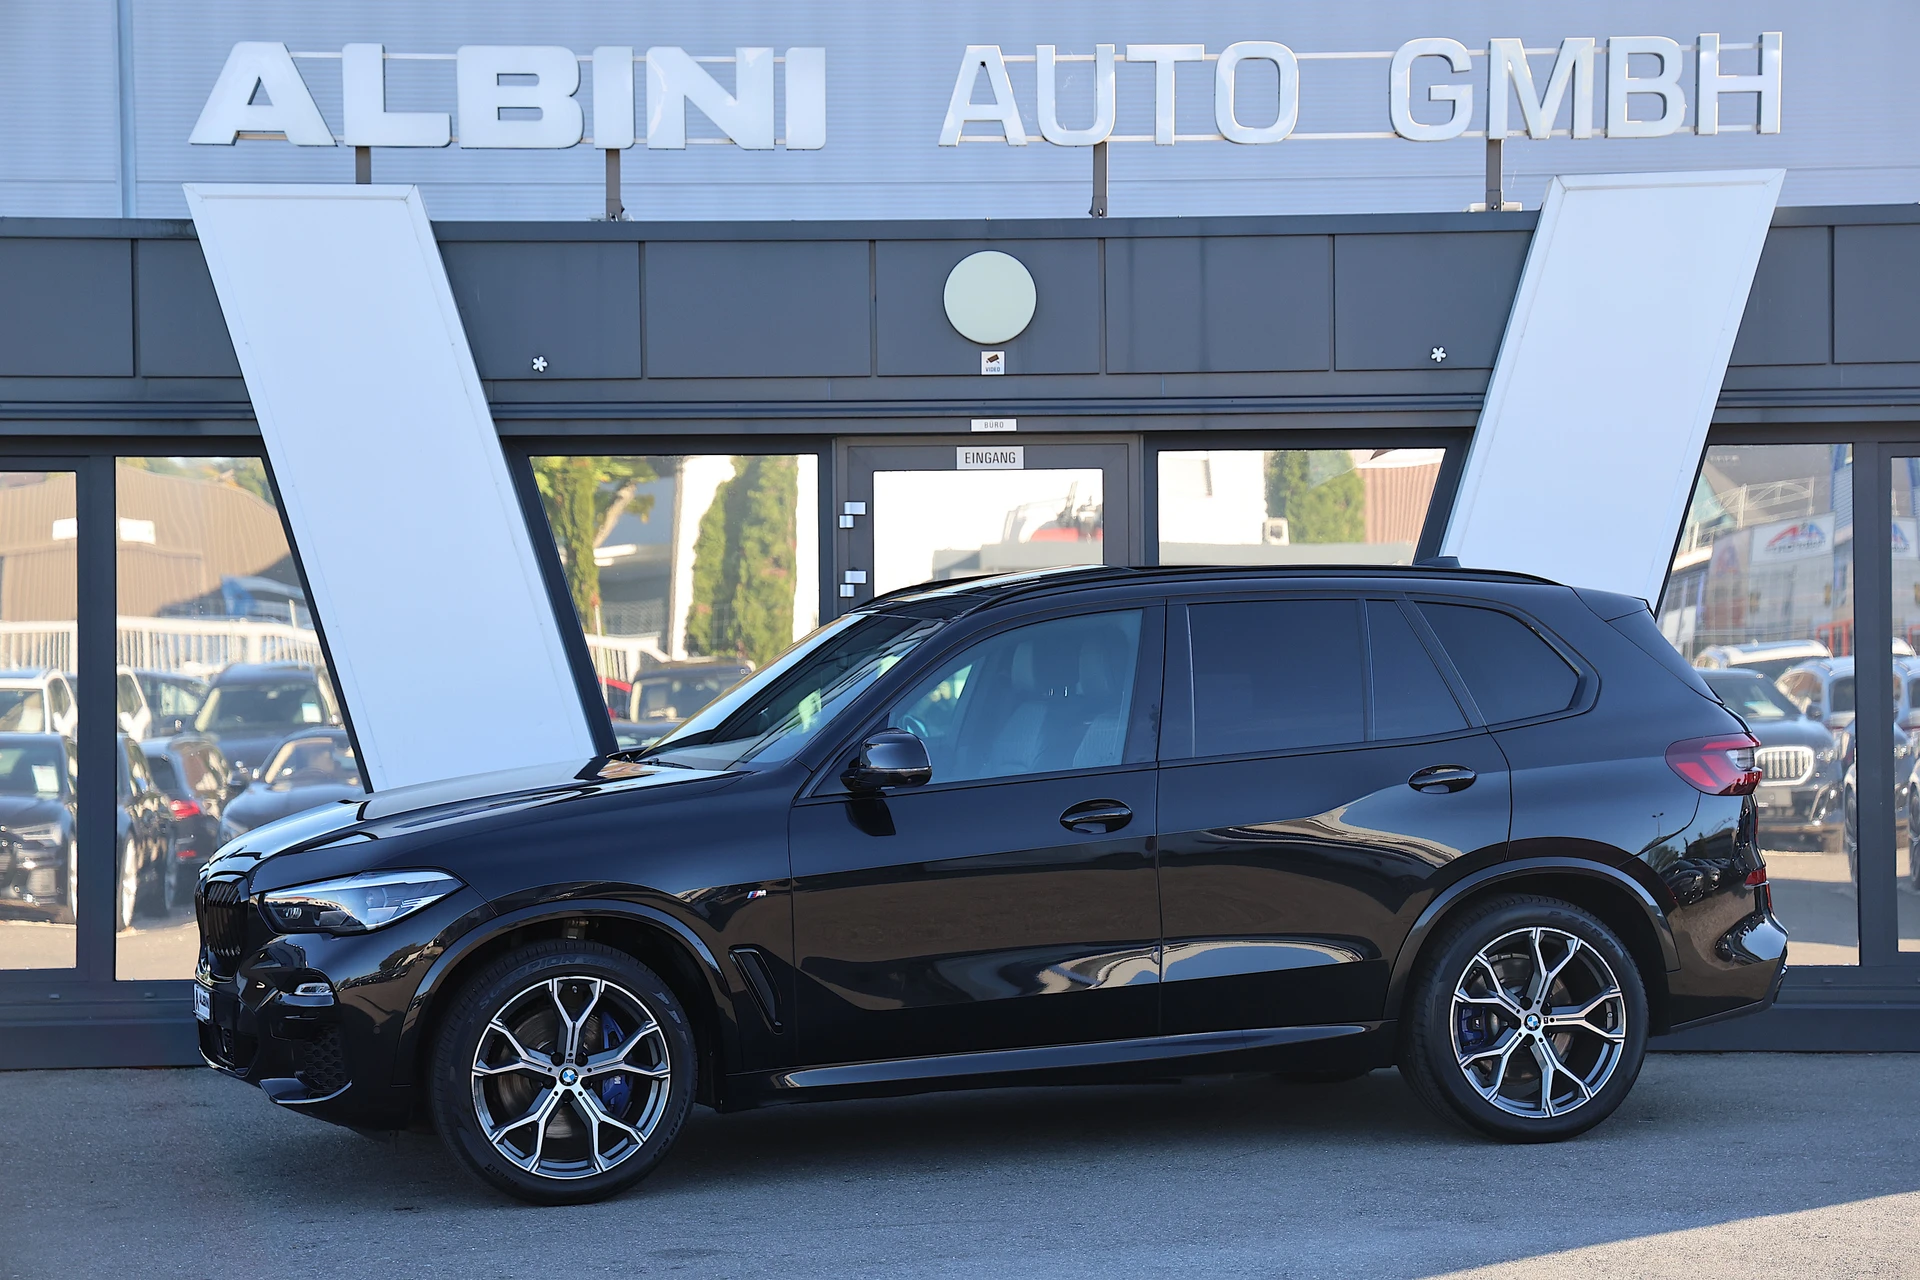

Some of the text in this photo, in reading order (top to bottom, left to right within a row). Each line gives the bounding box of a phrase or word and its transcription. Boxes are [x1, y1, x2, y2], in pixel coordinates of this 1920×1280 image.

[189, 31, 1783, 151] ALBINI AUTO GMBH
[984, 421, 1005, 429] BÜRO
[964, 452, 1016, 464] EINGANG
